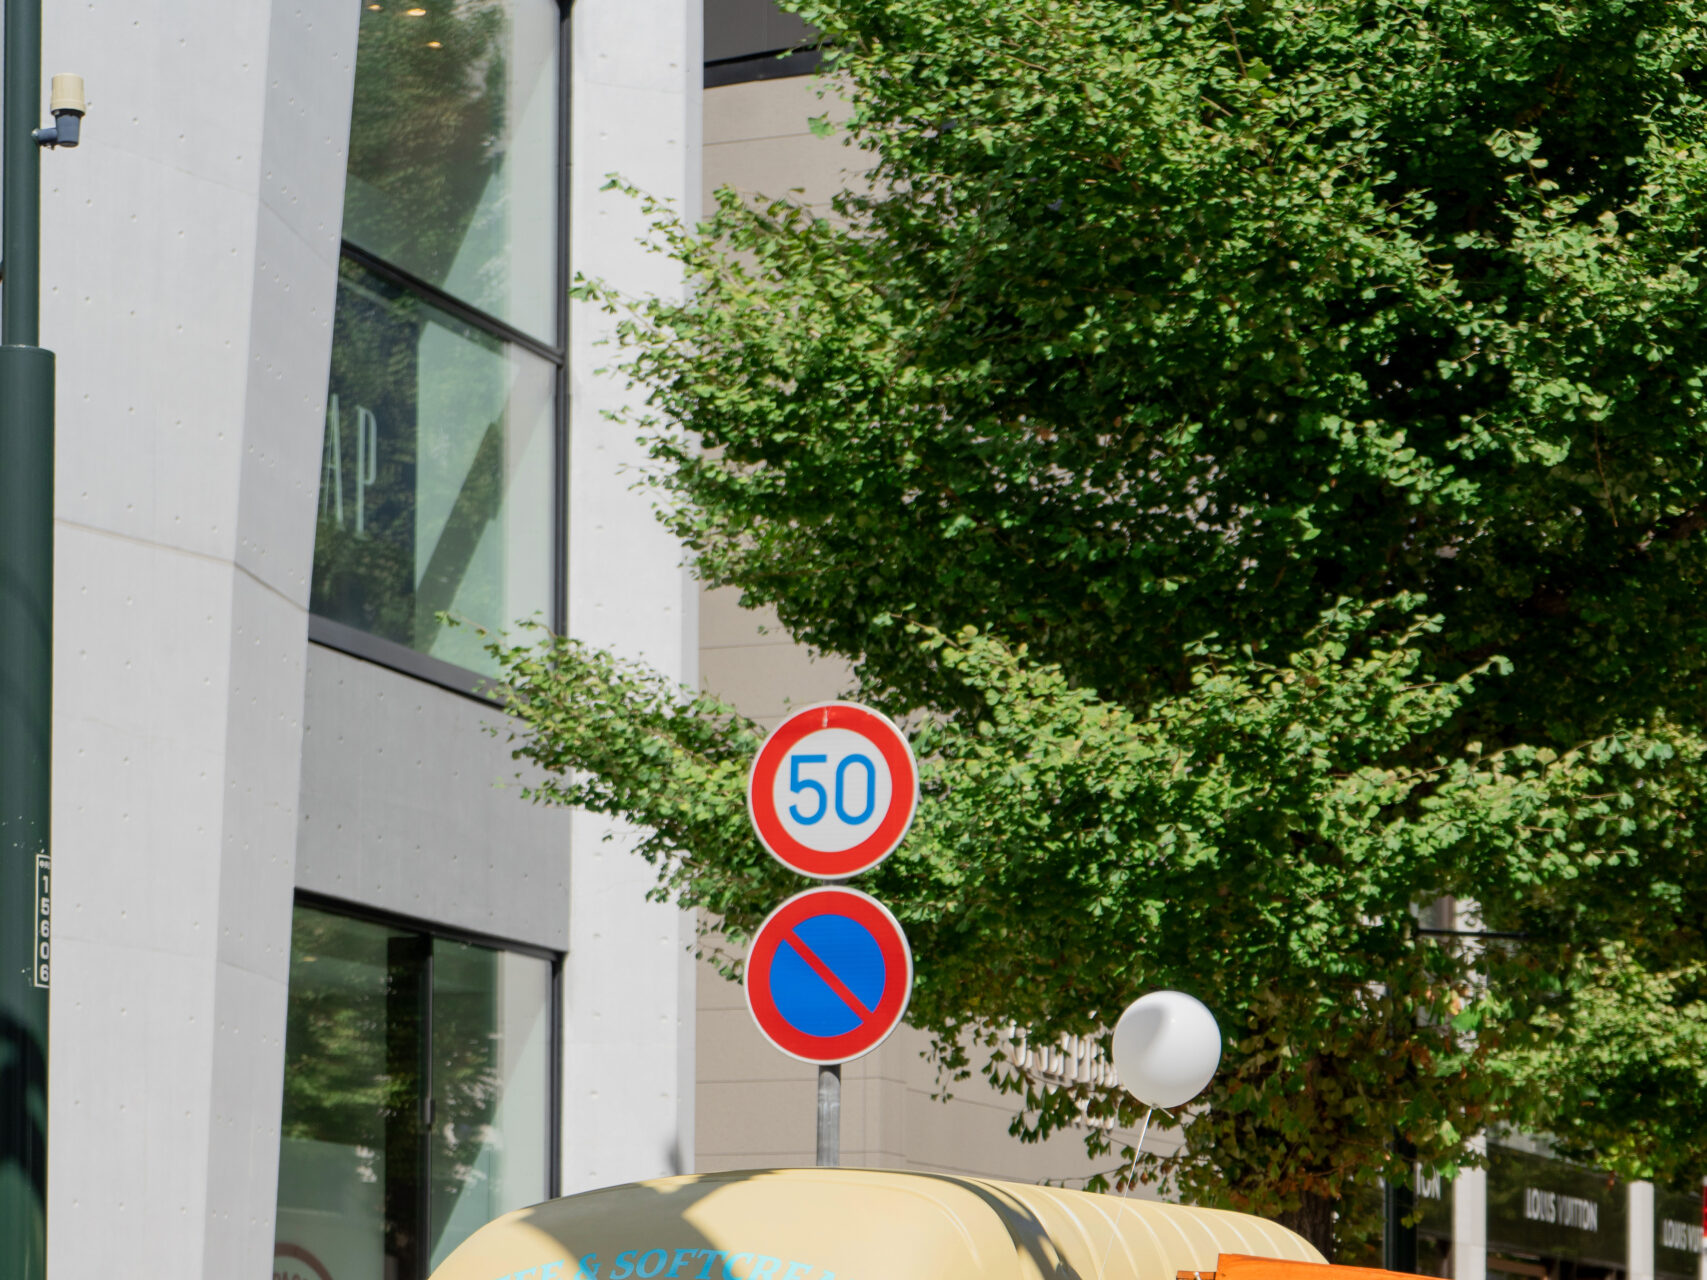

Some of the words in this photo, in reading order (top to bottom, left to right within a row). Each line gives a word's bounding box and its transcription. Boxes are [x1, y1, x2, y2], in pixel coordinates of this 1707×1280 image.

[789, 753, 876, 826] 50
[39, 875, 50, 983] 15606
[1526, 1188, 1556, 1224] LOUIS
[1557, 1196, 1598, 1232] VUITTON
[1663, 1218, 1687, 1251] LOUIS
